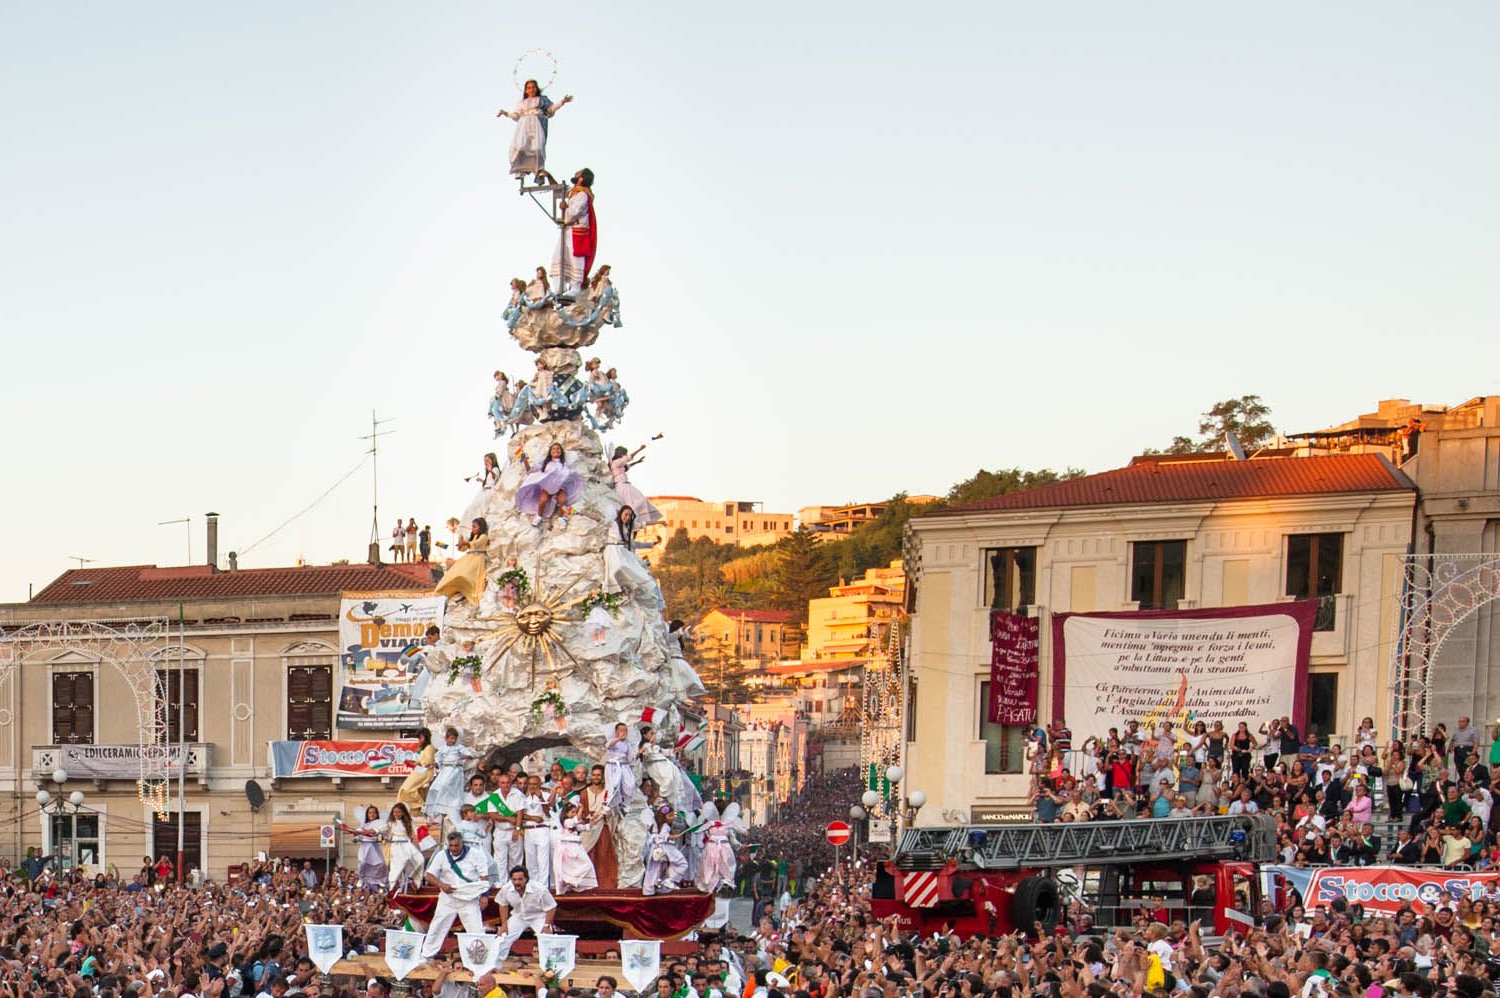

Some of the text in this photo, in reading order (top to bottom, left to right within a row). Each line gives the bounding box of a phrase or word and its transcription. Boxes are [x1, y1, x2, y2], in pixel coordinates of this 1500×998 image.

[1104, 629, 1141, 639] Ficimu
[1152, 631, 1178, 640] Varia
[1182, 632, 1223, 640] unendu
[1226, 631, 1235, 640] li
[380, 638, 428, 648] VIAGG
[1100, 641, 1146, 651] mentimu
[1208, 643, 1235, 652] forza
[1117, 654, 1131, 663] pe
[1133, 653, 1143, 661] la
[1190, 656, 1203, 666] pe
[1205, 654, 1215, 662] la
[1218, 652, 1245, 664] genti
[1213, 699, 1244, 708] supra
[1246, 695, 1271, 705] misi
[1095, 706, 1107, 715] pe
